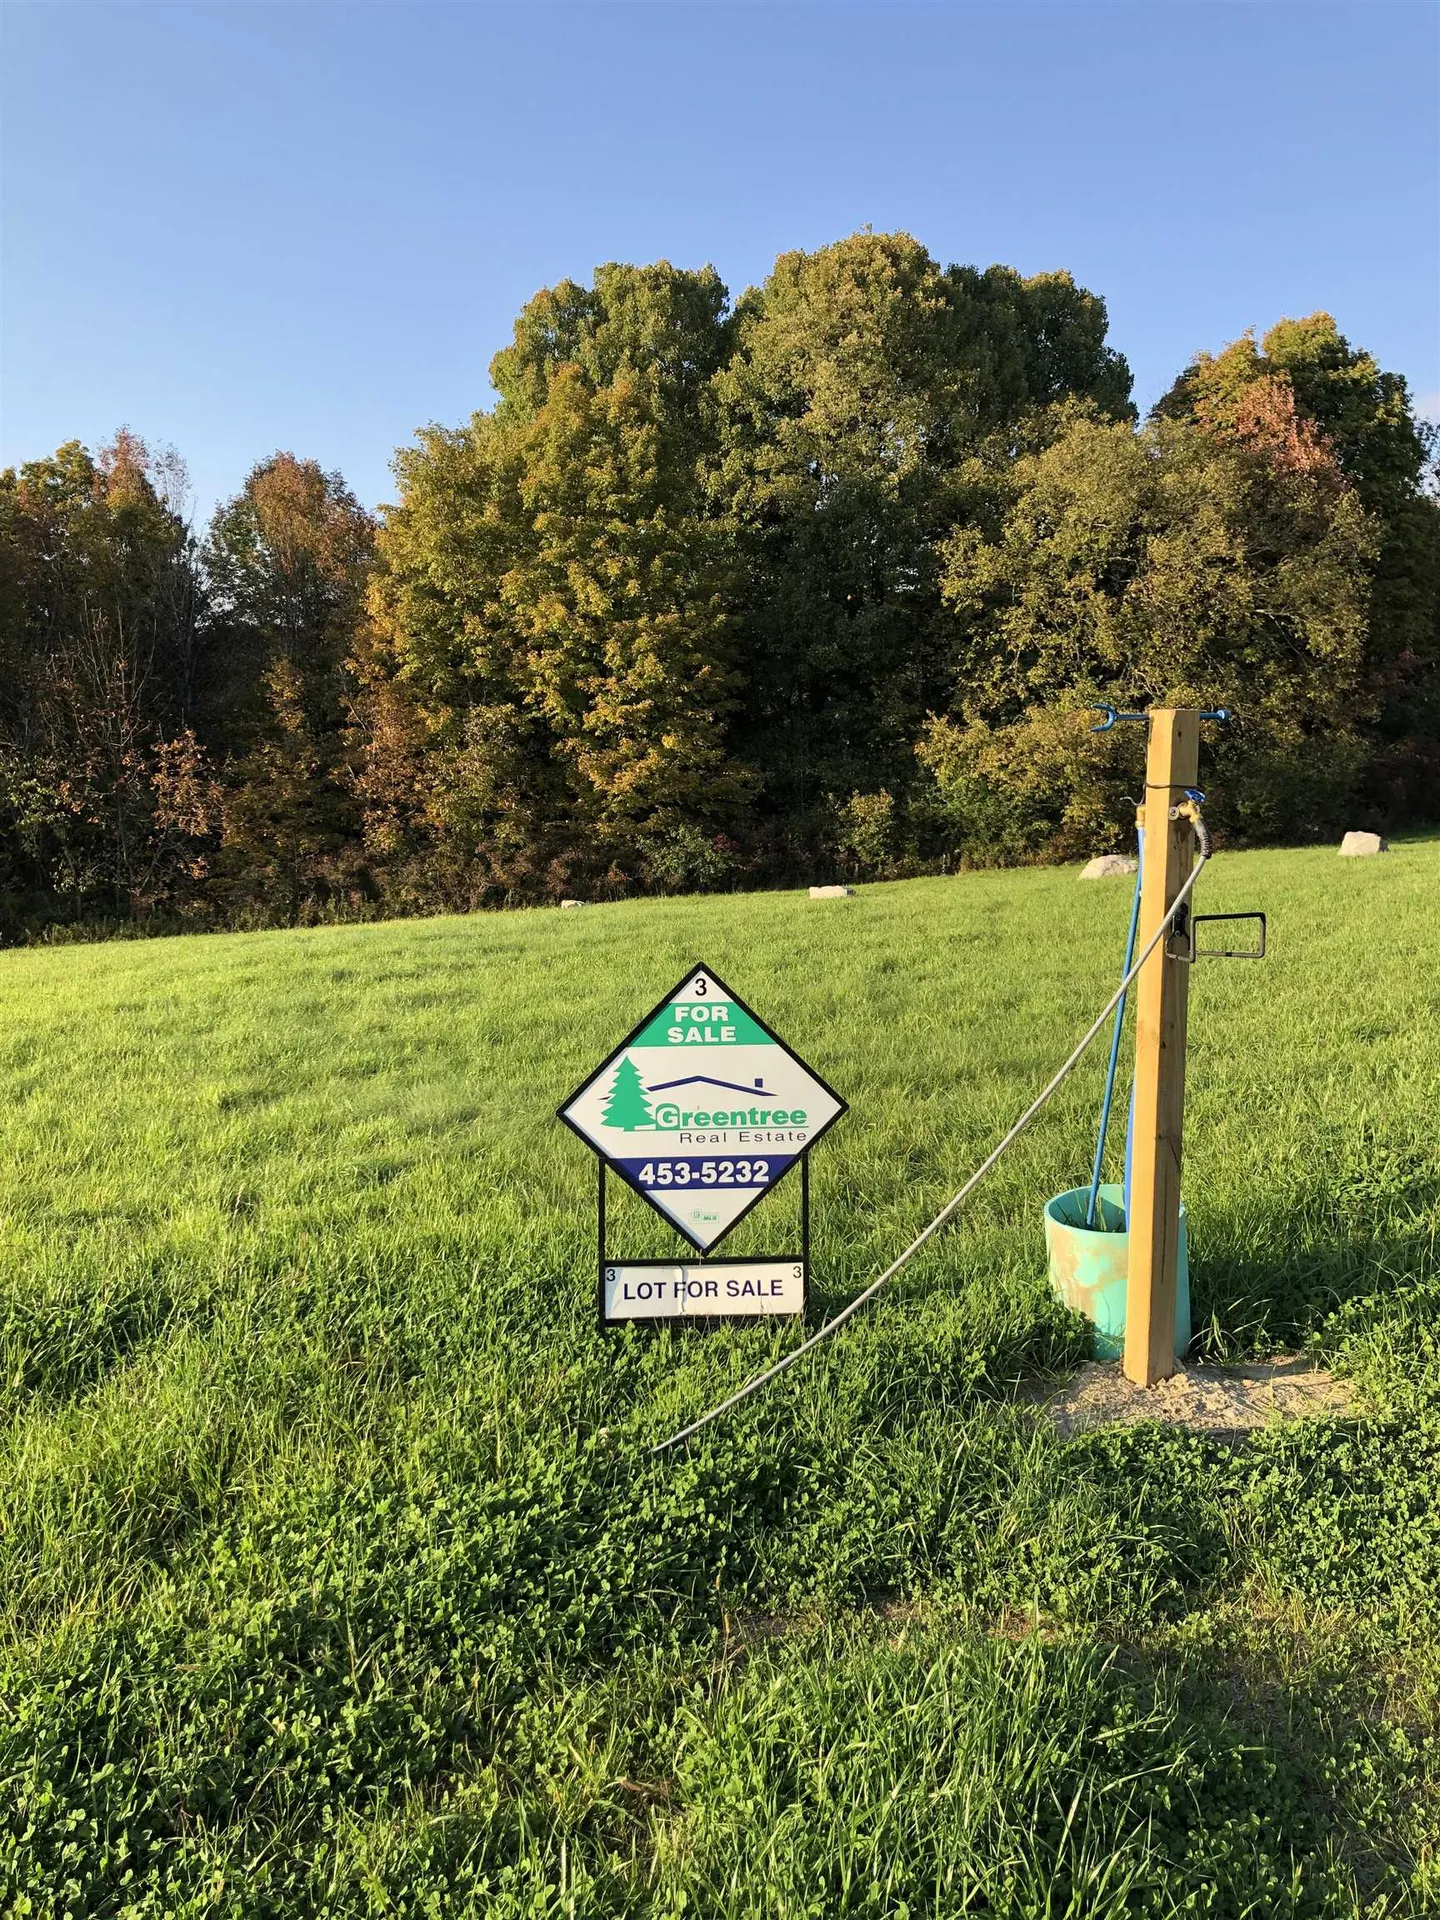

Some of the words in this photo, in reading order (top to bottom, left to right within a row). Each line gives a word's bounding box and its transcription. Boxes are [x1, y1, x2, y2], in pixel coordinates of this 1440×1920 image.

[694, 977, 708, 997] 3
[674, 1005, 729, 1022] FOR
[667, 1026, 737, 1043] SALE
[656, 1104, 808, 1129] Greentree
[679, 1131, 728, 1144] Real
[738, 1130, 808, 1143] Estate
[638, 1160, 770, 1185] 453-5232
[606, 1268, 616, 1282] 3
[792, 1265, 803, 1279] 3
[623, 1282, 667, 1300] LOT
[673, 1280, 719, 1299] FOR
[725, 1279, 784, 1298] SALE
